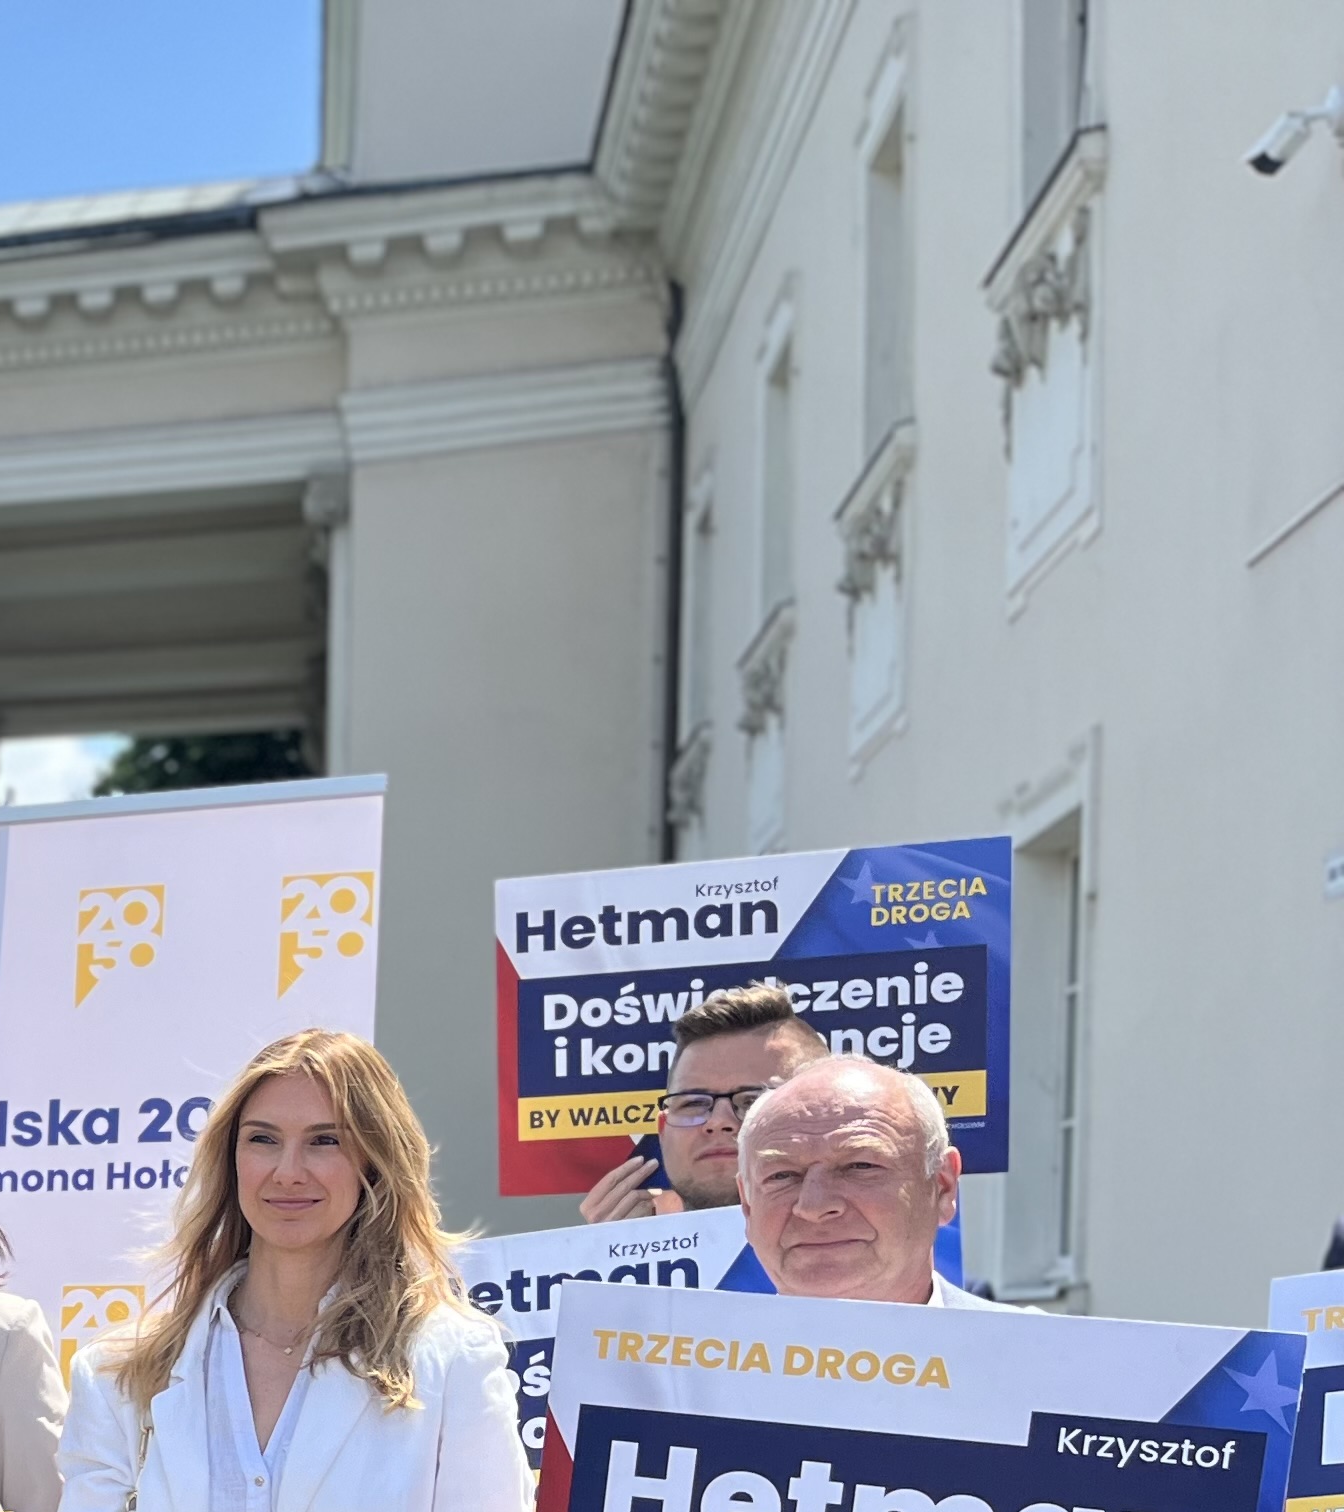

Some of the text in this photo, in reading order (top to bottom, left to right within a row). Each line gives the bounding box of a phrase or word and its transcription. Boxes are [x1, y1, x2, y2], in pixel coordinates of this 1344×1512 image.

[695, 876, 779, 899] Krzysztof
[871, 877, 987, 904] TRZECIA
[515, 898, 779, 954] Hetman
[870, 901, 971, 927] DROGA
[543, 962, 965, 1031] Doświczenie
[554, 1013, 952, 1078] i komncje
[137, 1096, 215, 1143] 20
[529, 1104, 656, 1129] BY WALCZ
[106, 1160, 190, 1190] Hoło
[609, 1232, 699, 1258] Krzysztof
[593, 1329, 950, 1389] TRZECIA DROGA
[1057, 1427, 1237, 1471] Krzysztof
